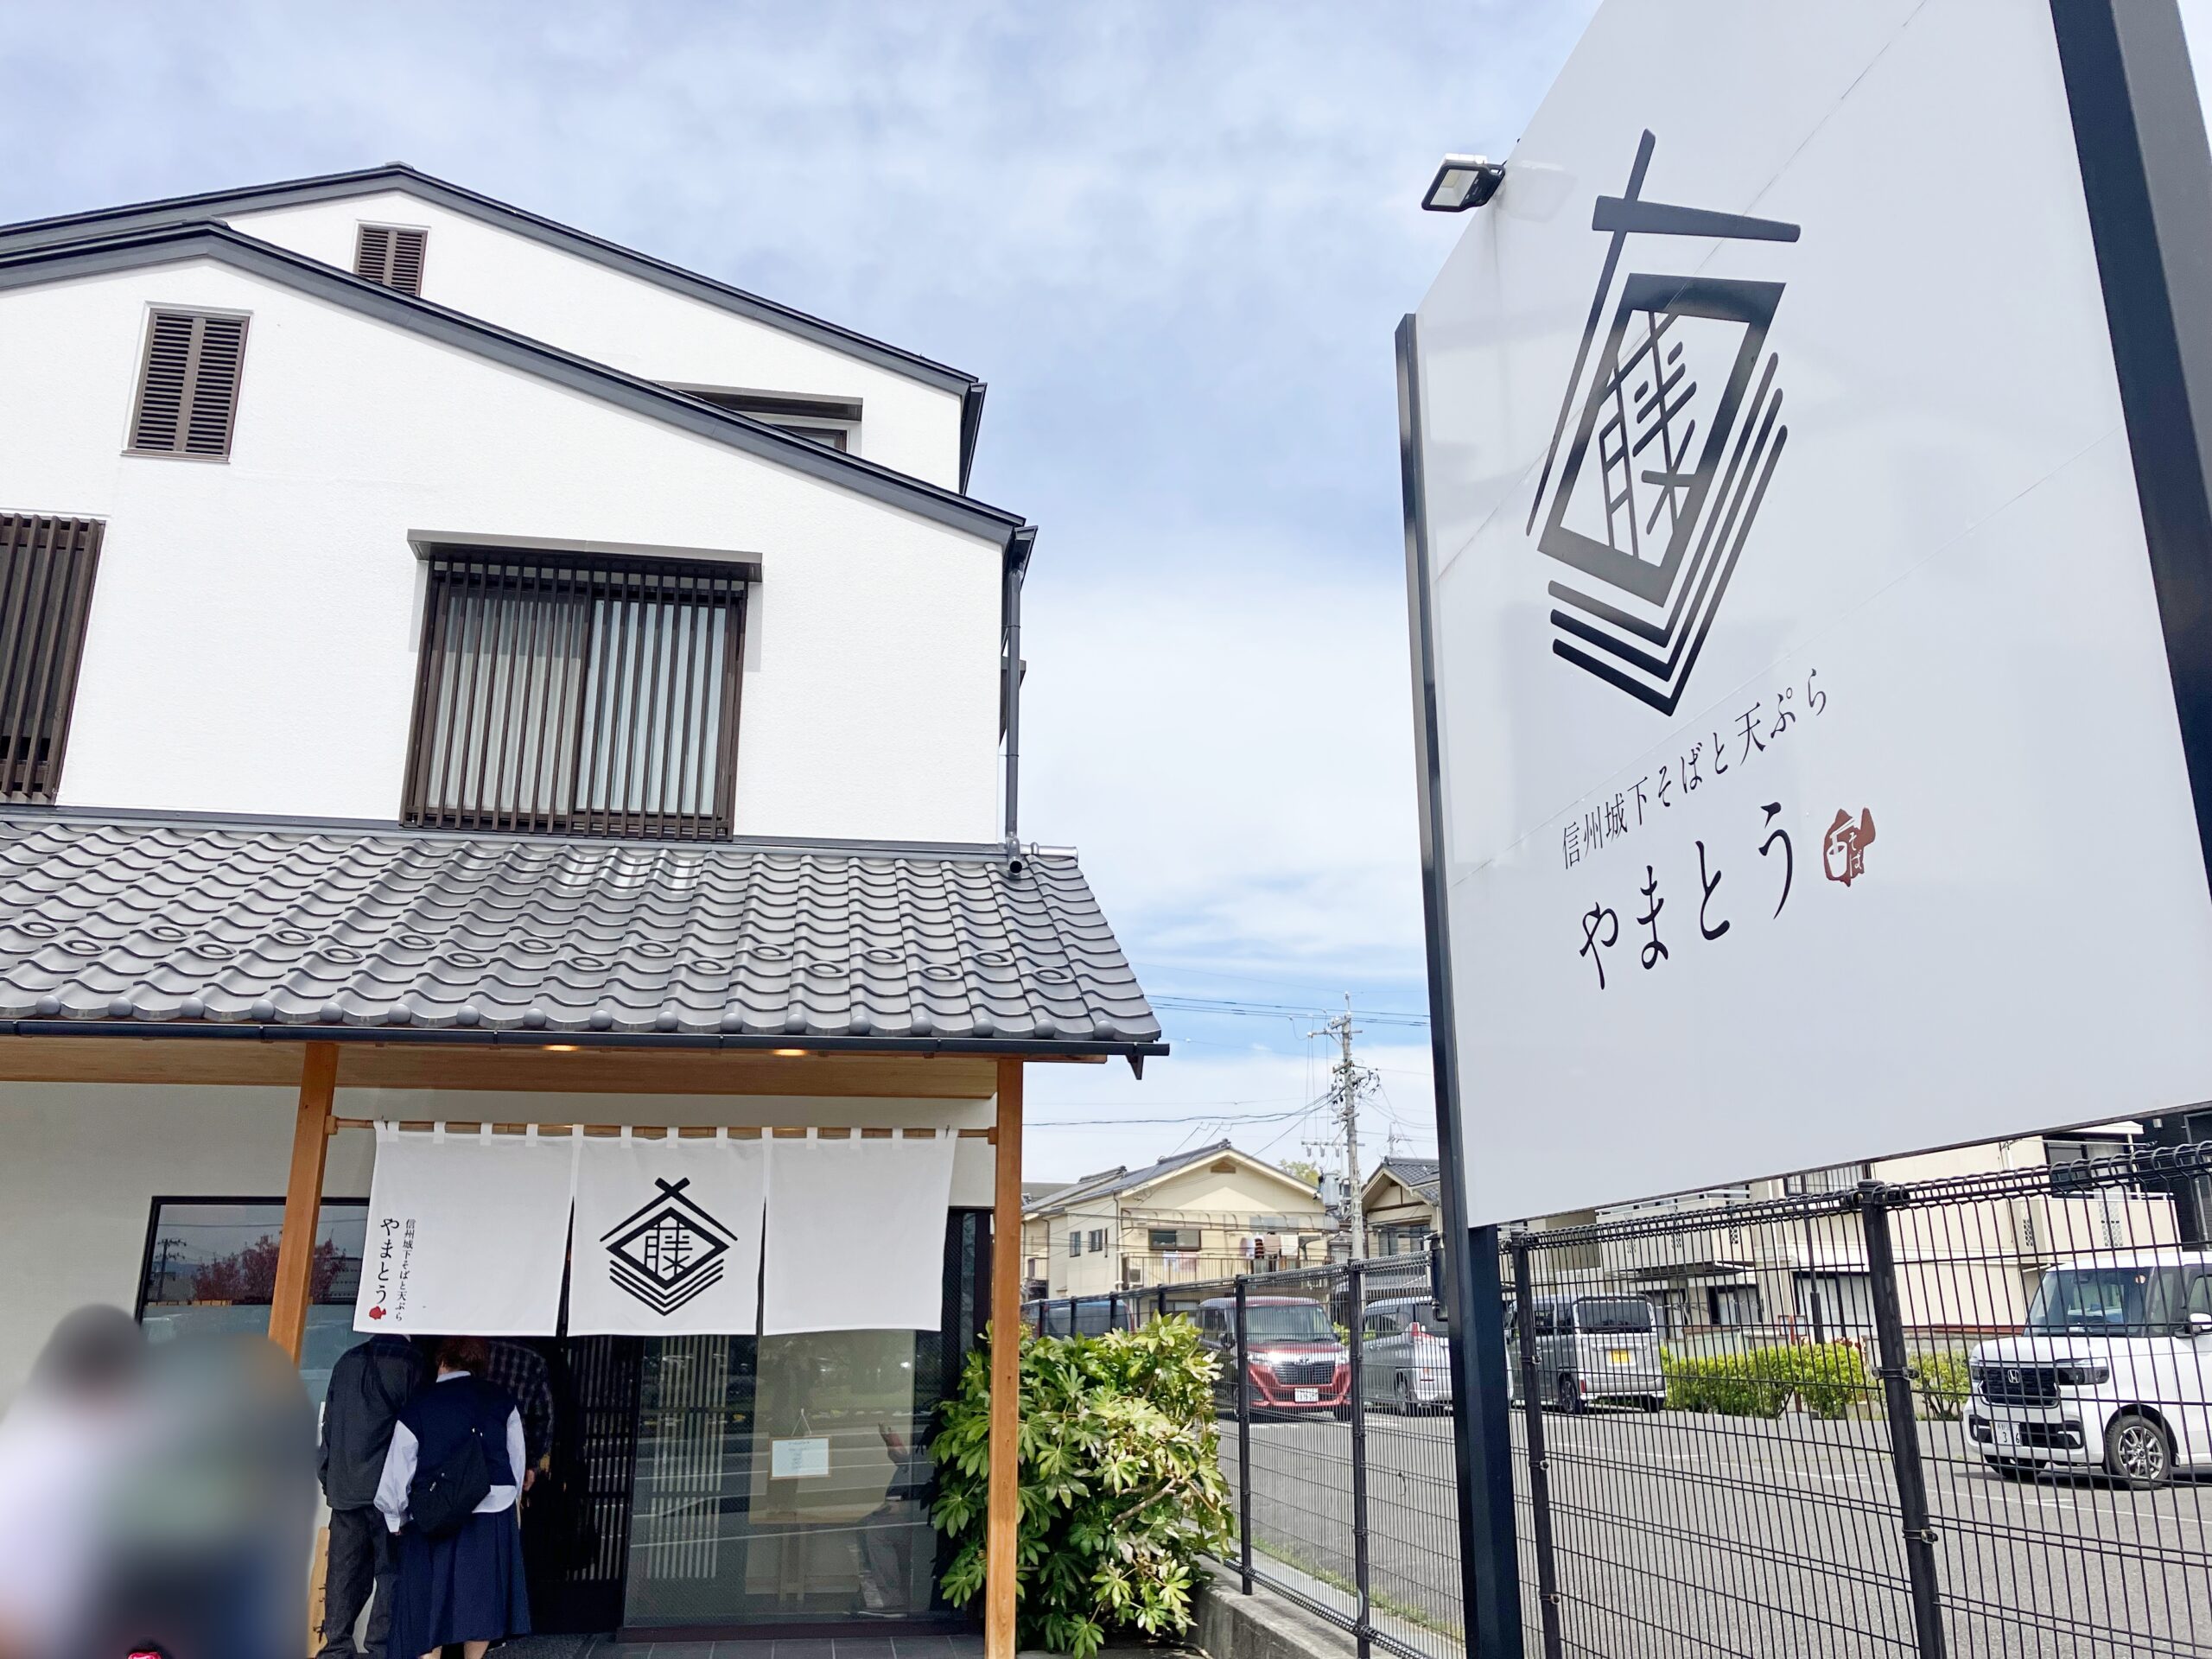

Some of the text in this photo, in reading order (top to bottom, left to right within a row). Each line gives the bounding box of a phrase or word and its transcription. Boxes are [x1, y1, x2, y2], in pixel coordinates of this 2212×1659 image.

[1560, 667, 1827, 870] 信州城下そばと天ぷら
[1579, 801, 1793, 990] やまとう
[1848, 831, 1864, 877] そば
[375, 1218, 400, 1304] やまとう
